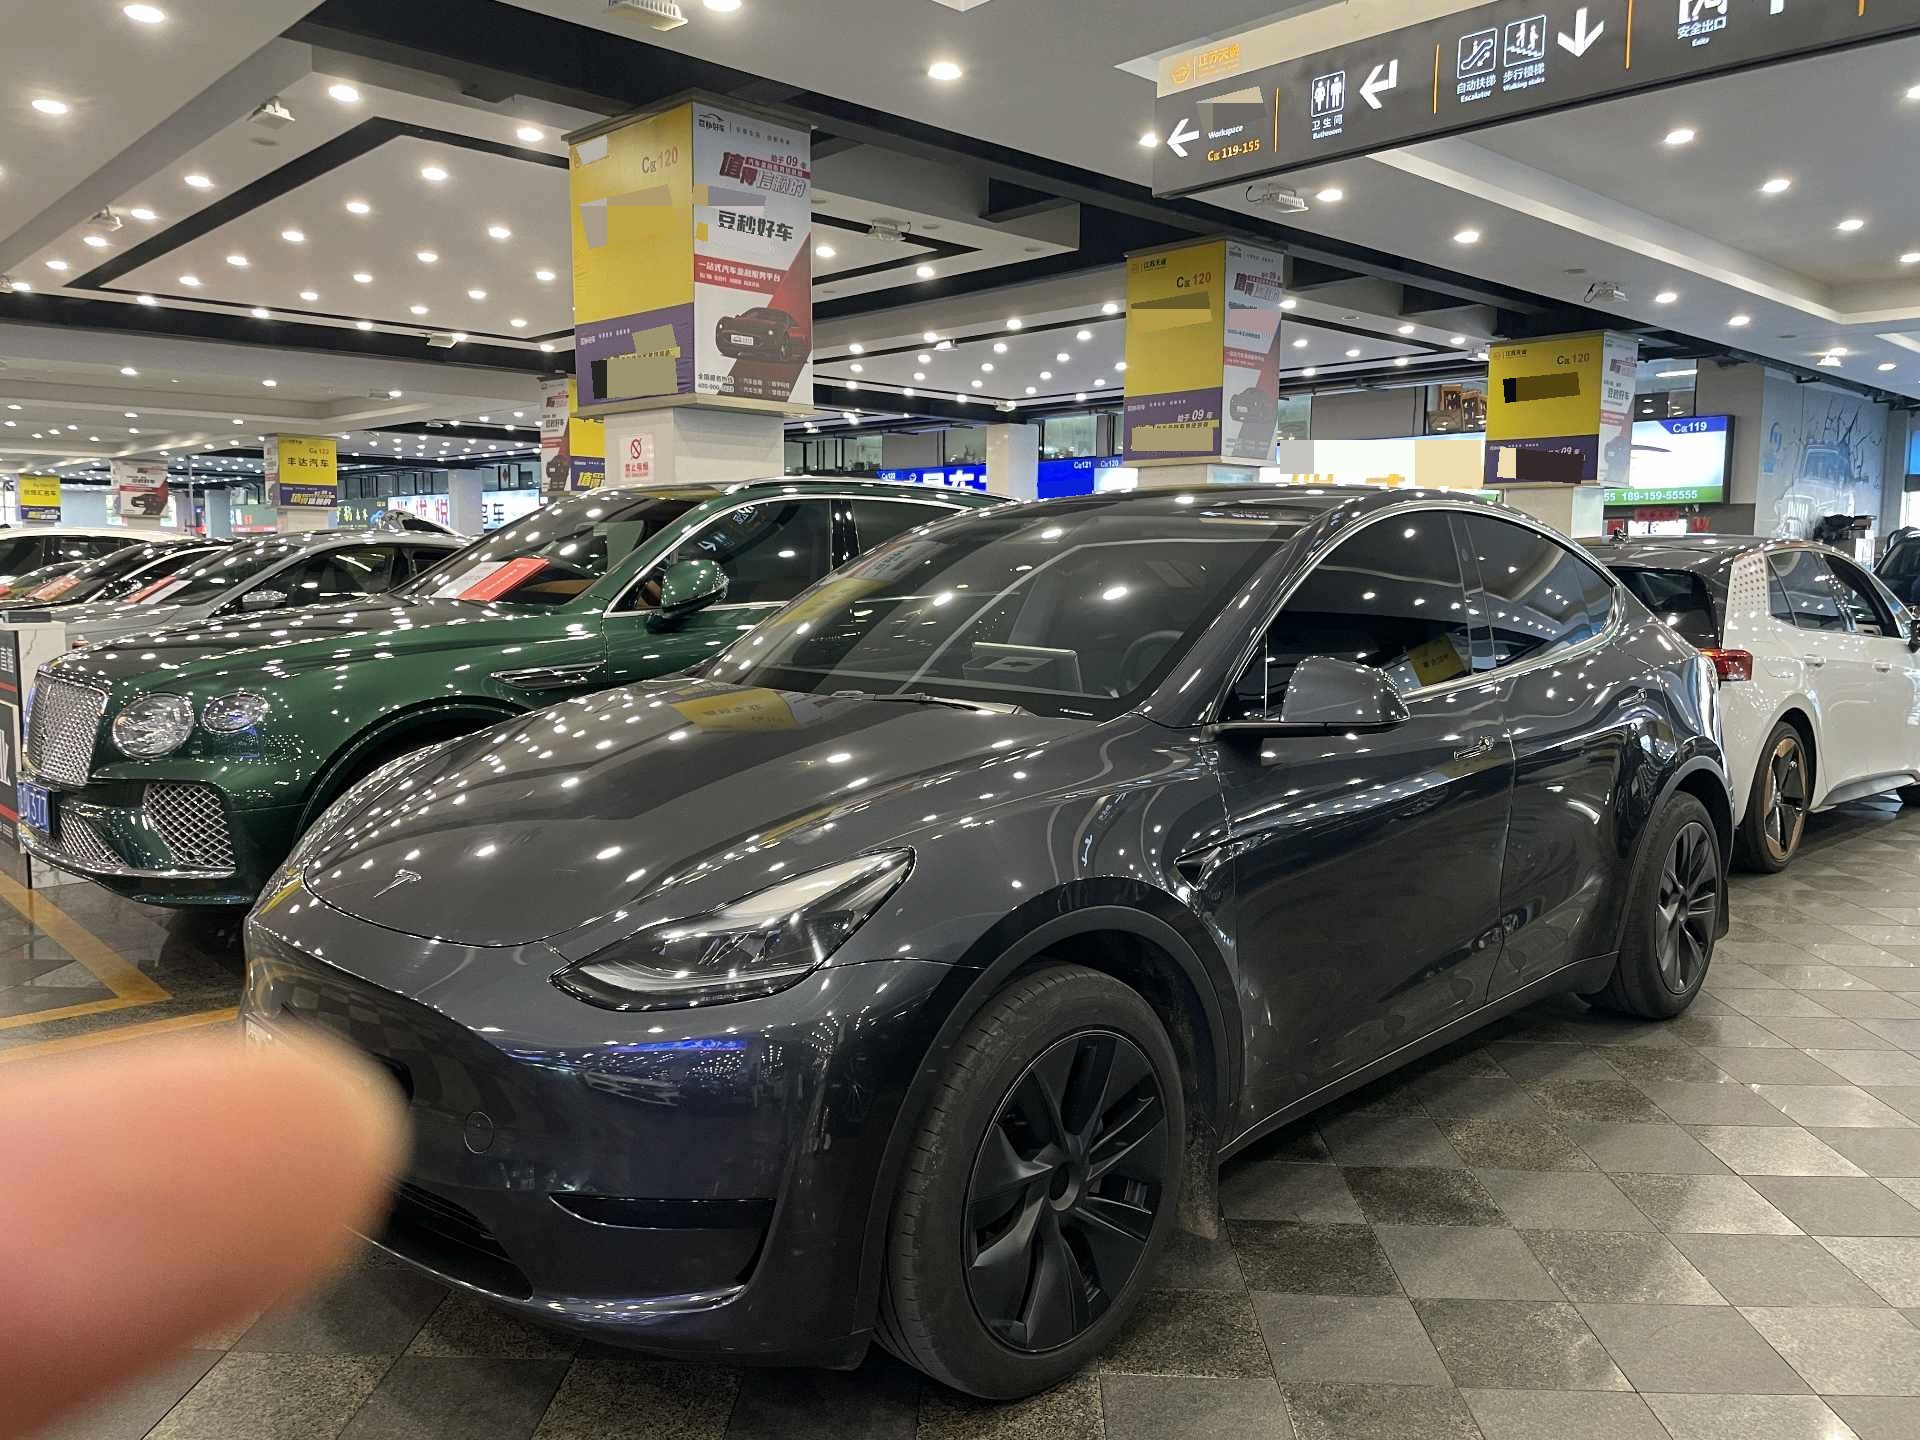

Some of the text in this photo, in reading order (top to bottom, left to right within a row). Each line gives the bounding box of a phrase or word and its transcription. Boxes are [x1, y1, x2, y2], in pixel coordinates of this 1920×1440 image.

[1677, 15, 1727, 40] 安全出口
[1456, 73, 1497, 95] 自动扶梯
[1502, 62, 1545, 84] 步行楼梯
[1460, 89, 1492, 103] Escalator
[1208, 124, 1244, 140] Workspace
[1311, 114, 1343, 132] 卫生间
[718, 209, 794, 242] 豆秒好车
